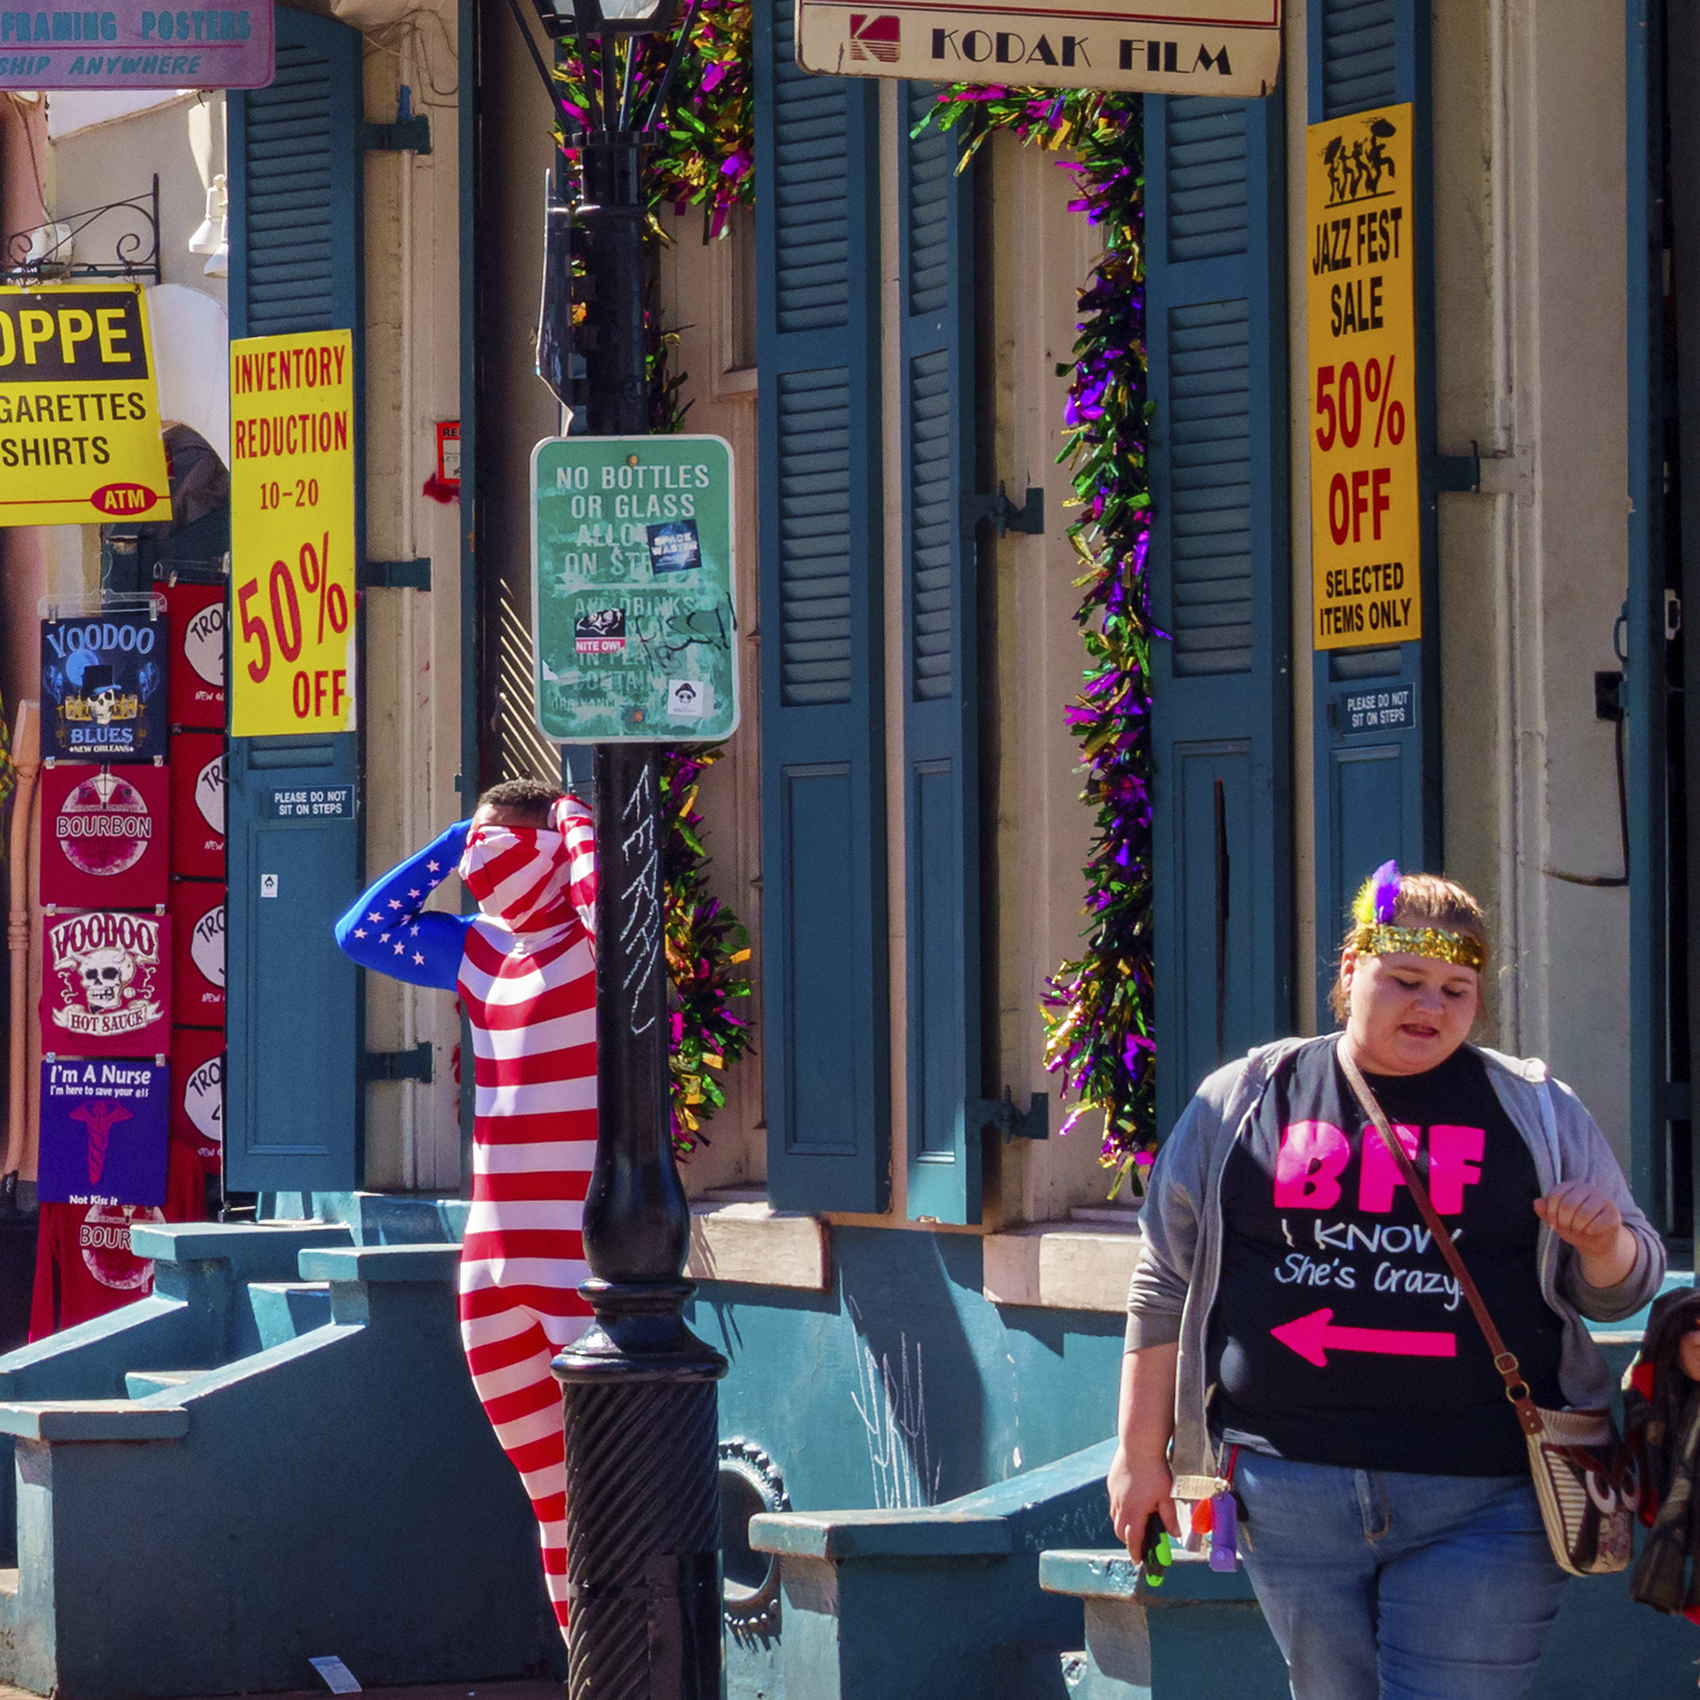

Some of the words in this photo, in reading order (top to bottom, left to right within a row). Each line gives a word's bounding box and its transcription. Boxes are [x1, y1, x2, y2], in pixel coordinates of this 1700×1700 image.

[2, 10, 117, 42] FRAMING
[141, 10, 252, 41] POSTERS
[931, 27, 1092, 68] KODAK
[1118, 38, 1232, 76] FILM
[67, 55, 202, 76] ANYWHERE
[1313, 218, 1352, 276] JAZZ
[1357, 207, 1402, 266] FEST
[1331, 275, 1383, 338] SALE
[235, 345, 345, 394] INVENTORY
[1316, 354, 1405, 452] 50%
[235, 410, 348, 459] REDUCTION
[557, 467, 589, 490] NO
[602, 465, 710, 489] BOTTLES
[104, 489, 146, 510] ATM
[260, 478, 319, 510] 10-20
[571, 495, 602, 519] OR
[615, 494, 696, 518] GLASS
[1329, 467, 1391, 546] OFF
[577, 523, 647, 548] ALLO
[565, 553, 597, 576] ON
[1326, 562, 1404, 598] SELECTED
[237, 530, 348, 684] 50%
[1320, 603, 1364, 635] ITEMS
[1369, 598, 1412, 630] ONLY
[46, 623, 155, 659] VOODOO
[576, 641, 599, 652] NITE
[292, 669, 347, 719] OFF
[1347, 694, 1376, 712] PLEASE
[1378, 692, 1390, 707] DO
[1391, 690, 1409, 705] NOT
[1352, 712, 1365, 728] SIT
[1366, 710, 1378, 725] ON
[1380, 706, 1405, 723] STEPS
[70, 728, 134, 745] BLUES
[274, 792, 307, 803] PLEASE
[310, 791, 324, 802] DO
[327, 791, 347, 801] NOT
[279, 804, 293, 815] SIT
[296, 804, 309, 815] ON
[312, 803, 342, 814] STEPS
[56, 816, 152, 838] BOURBON
[54, 913, 156, 959] VOODOO
[70, 1014, 100, 1032] HOT
[102, 1011, 144, 1033] SAUCE
[50, 1065, 78, 1083] I'm
[83, 1064, 96, 1083] A
[101, 1065, 152, 1084] Nurse
[50, 1085, 64, 1095] I'm
[66, 1085, 83, 1095] here
[85, 1085, 94, 1095] to
[96, 1088, 113, 1097] save
[114, 1088, 134, 1099] your
[1274, 1119, 1485, 1215] BFF
[69, 1195, 88, 1205] Not
[90, 1195, 108, 1205] Kiss
[110, 1196, 118, 1206] it
[79, 1224, 132, 1249] BOUR
[1281, 1218, 1295, 1248] I
[1274, 1253, 1356, 1290] She's
